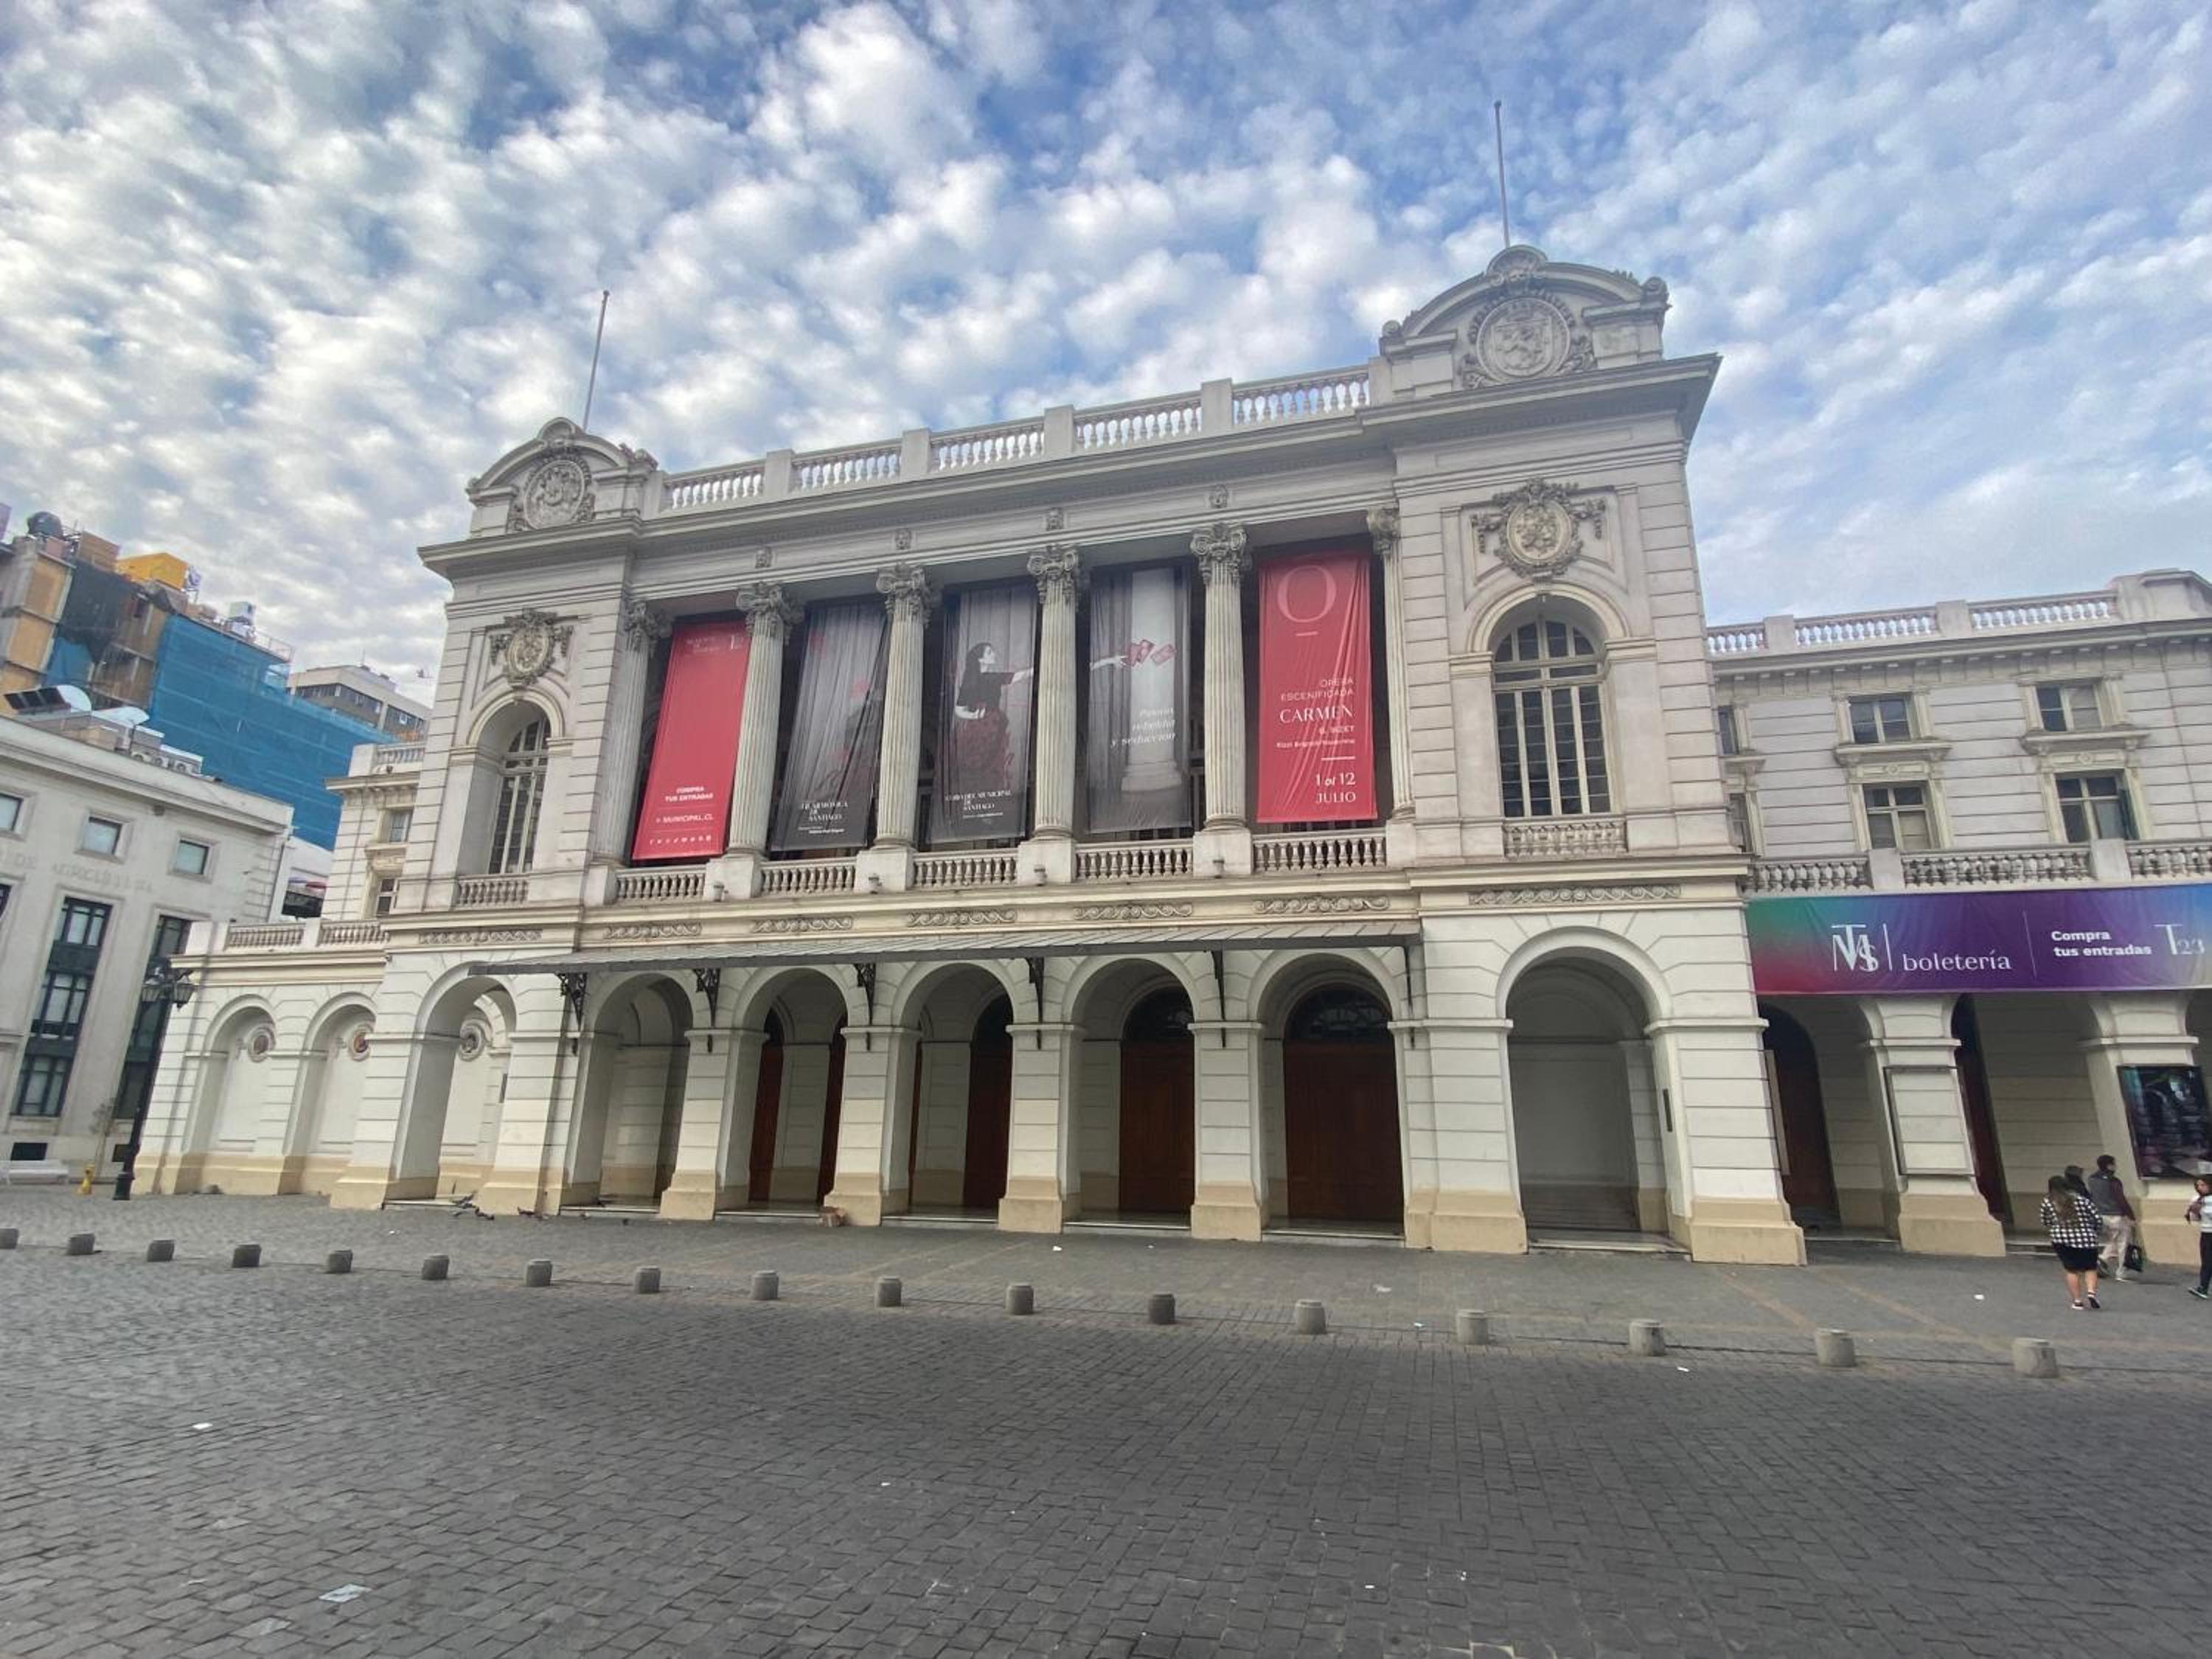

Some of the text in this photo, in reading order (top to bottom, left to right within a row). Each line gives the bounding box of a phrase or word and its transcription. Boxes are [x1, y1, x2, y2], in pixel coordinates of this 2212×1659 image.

[1279, 704, 1354, 723] CARMEN
[1315, 773, 1321, 786] 1
[1340, 772, 1356, 785] 12
[1317, 791, 1356, 804] JULIO
[2051, 930, 2112, 943] Compra
[2053, 944, 2152, 957] tus entradas
[1902, 948, 2012, 972] boletería
